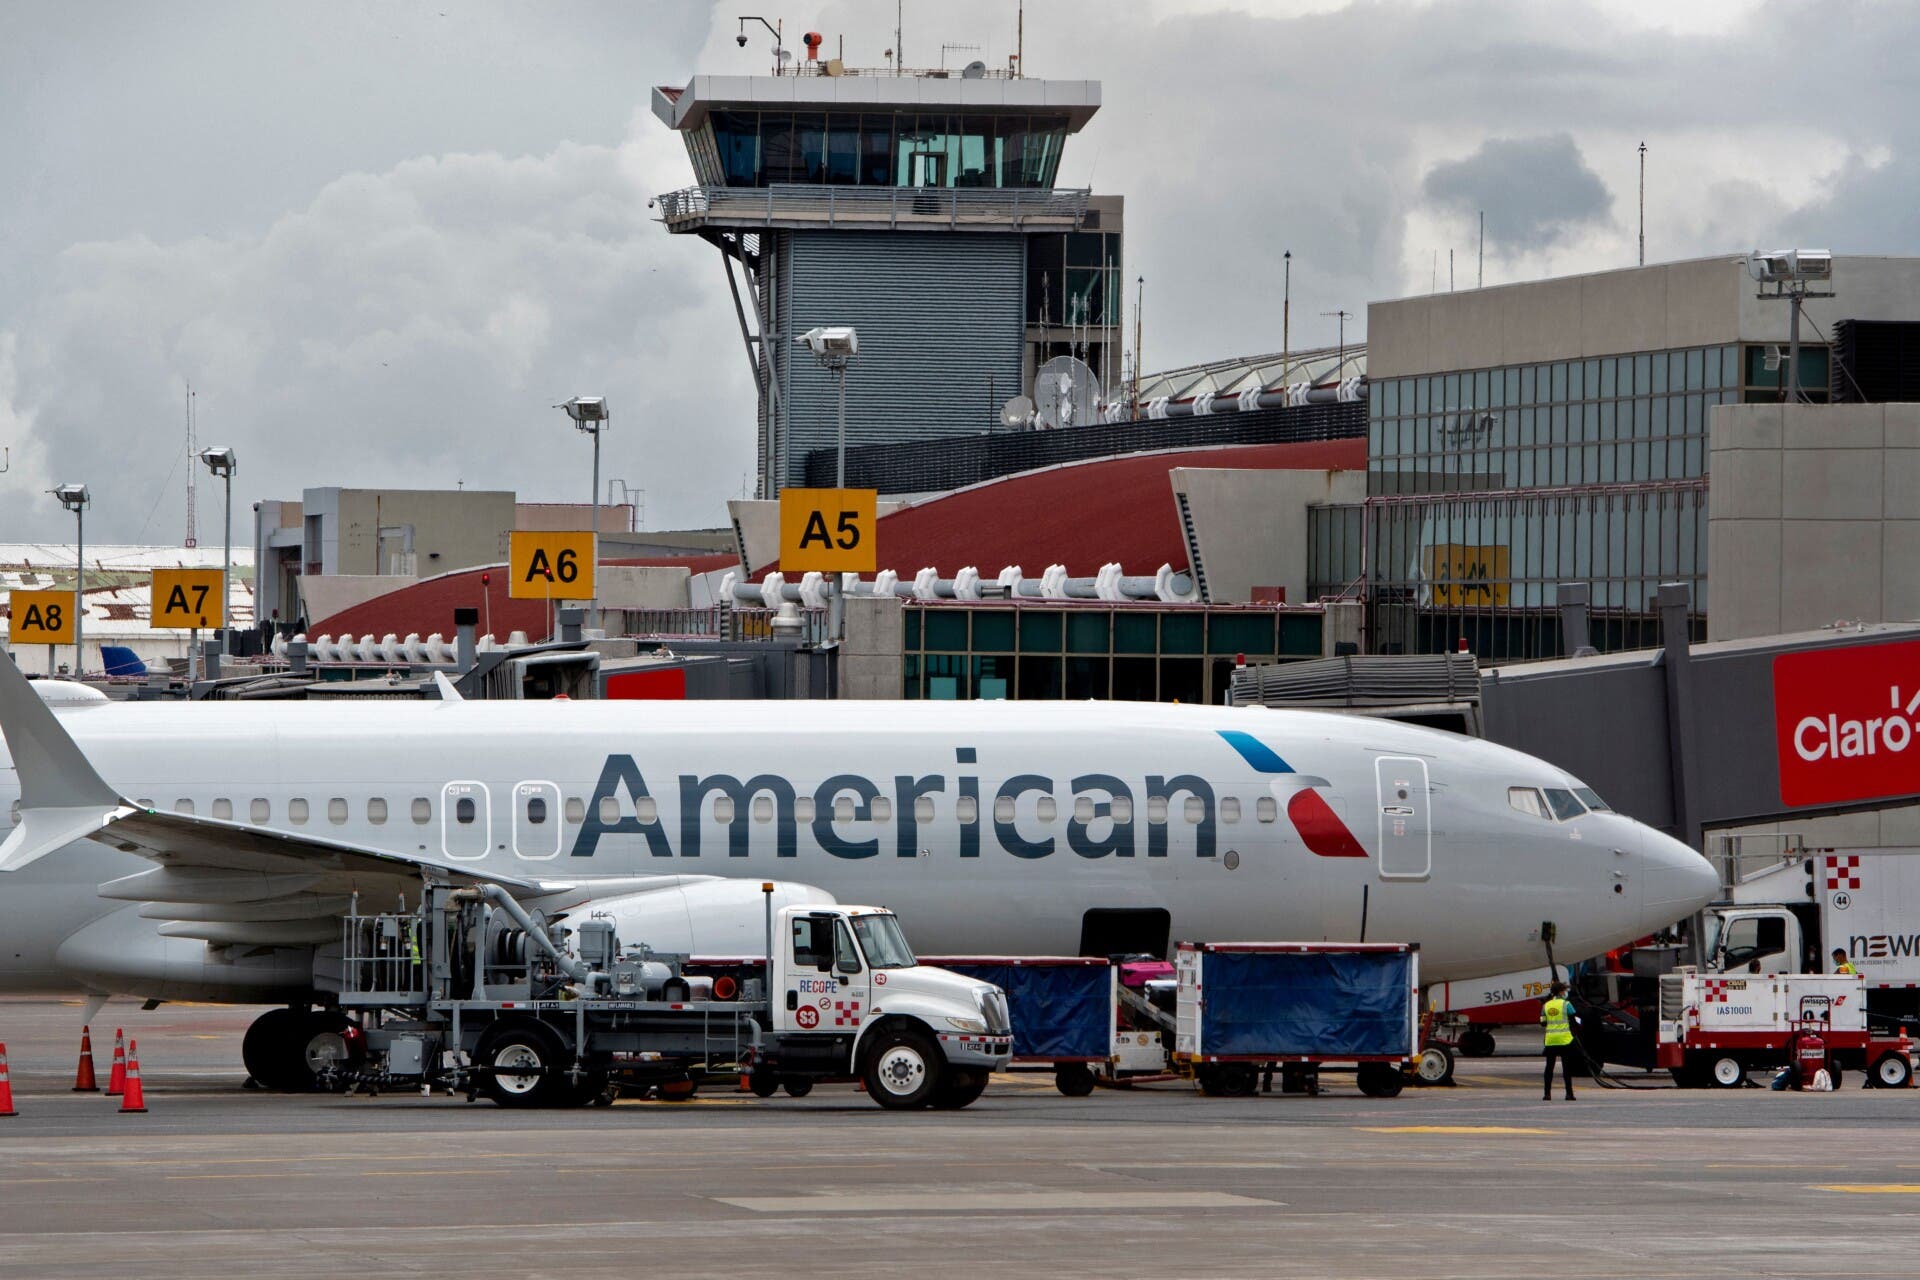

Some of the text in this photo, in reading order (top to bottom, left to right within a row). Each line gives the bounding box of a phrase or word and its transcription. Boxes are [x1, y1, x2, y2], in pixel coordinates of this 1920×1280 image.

[798, 510, 861, 551] A5
[524, 548, 578, 584] A6
[164, 583, 210, 615] A7
[20, 603, 63, 632] A8
[1793, 713, 1911, 762] Claro
[570, 746, 1218, 861] American
[1836, 896, 1848, 905] 44
[800, 979, 838, 993] RECOPE
[876, 974, 886, 983] S3
[1483, 988, 1514, 1004] 3SM
[800, 1010, 817, 1025] S3
